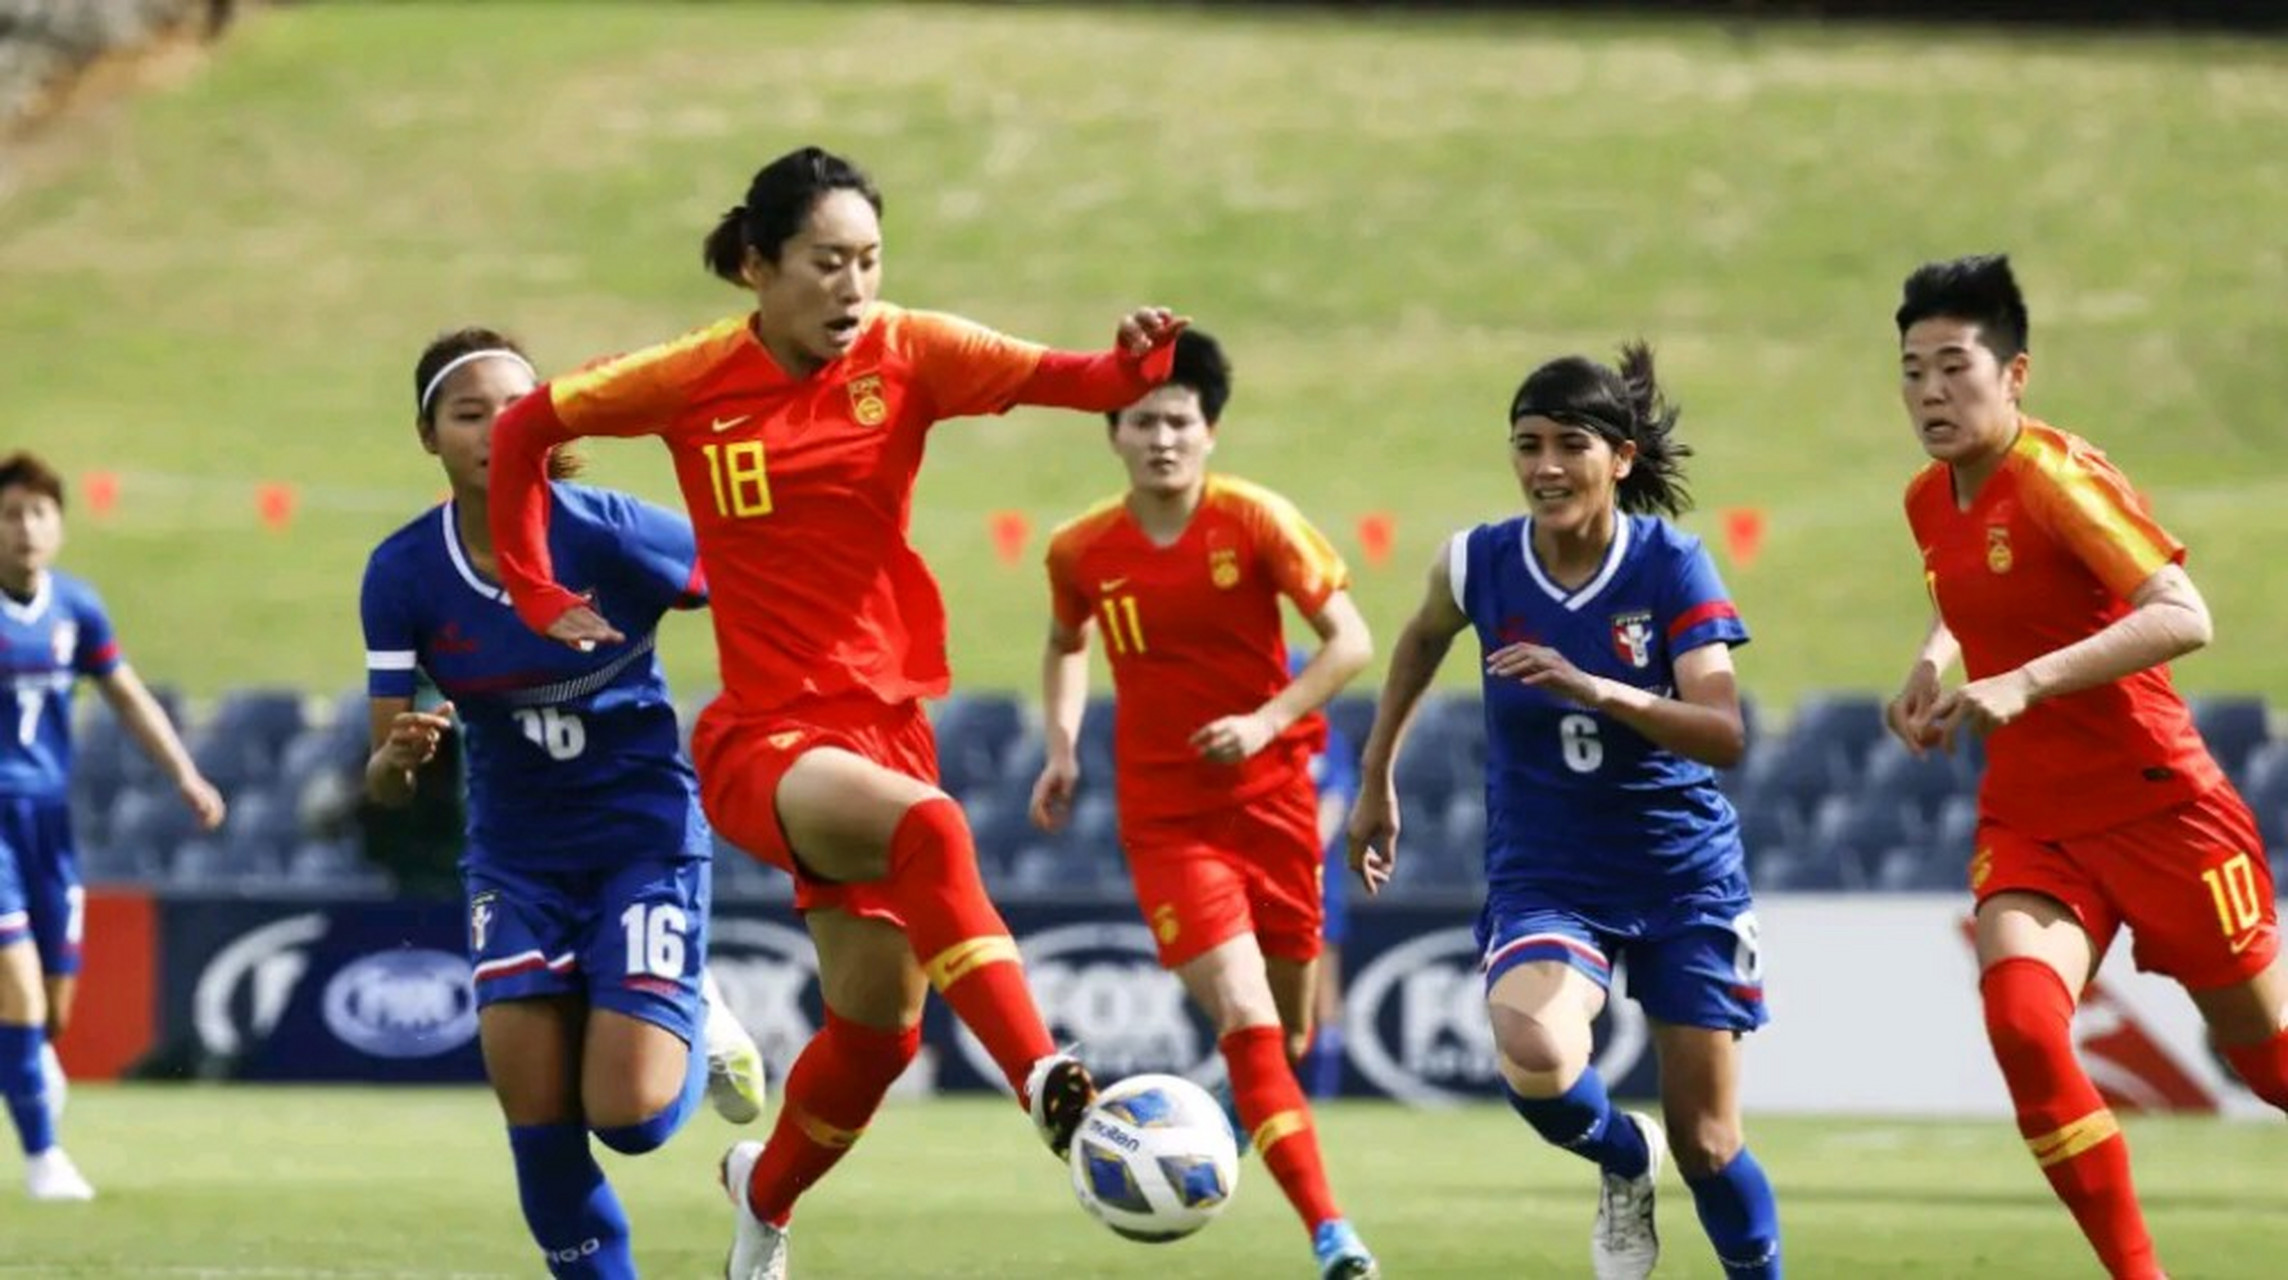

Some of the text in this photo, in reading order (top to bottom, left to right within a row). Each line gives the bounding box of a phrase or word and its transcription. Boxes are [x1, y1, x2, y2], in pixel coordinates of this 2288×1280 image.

[702, 440, 773, 517] 18
[1103, 595, 1146, 655] 11
[16, 680, 45, 746] 7
[1560, 714, 1604, 772] 6
[2202, 850, 2261, 936] 10
[621, 902, 686, 979] 16
